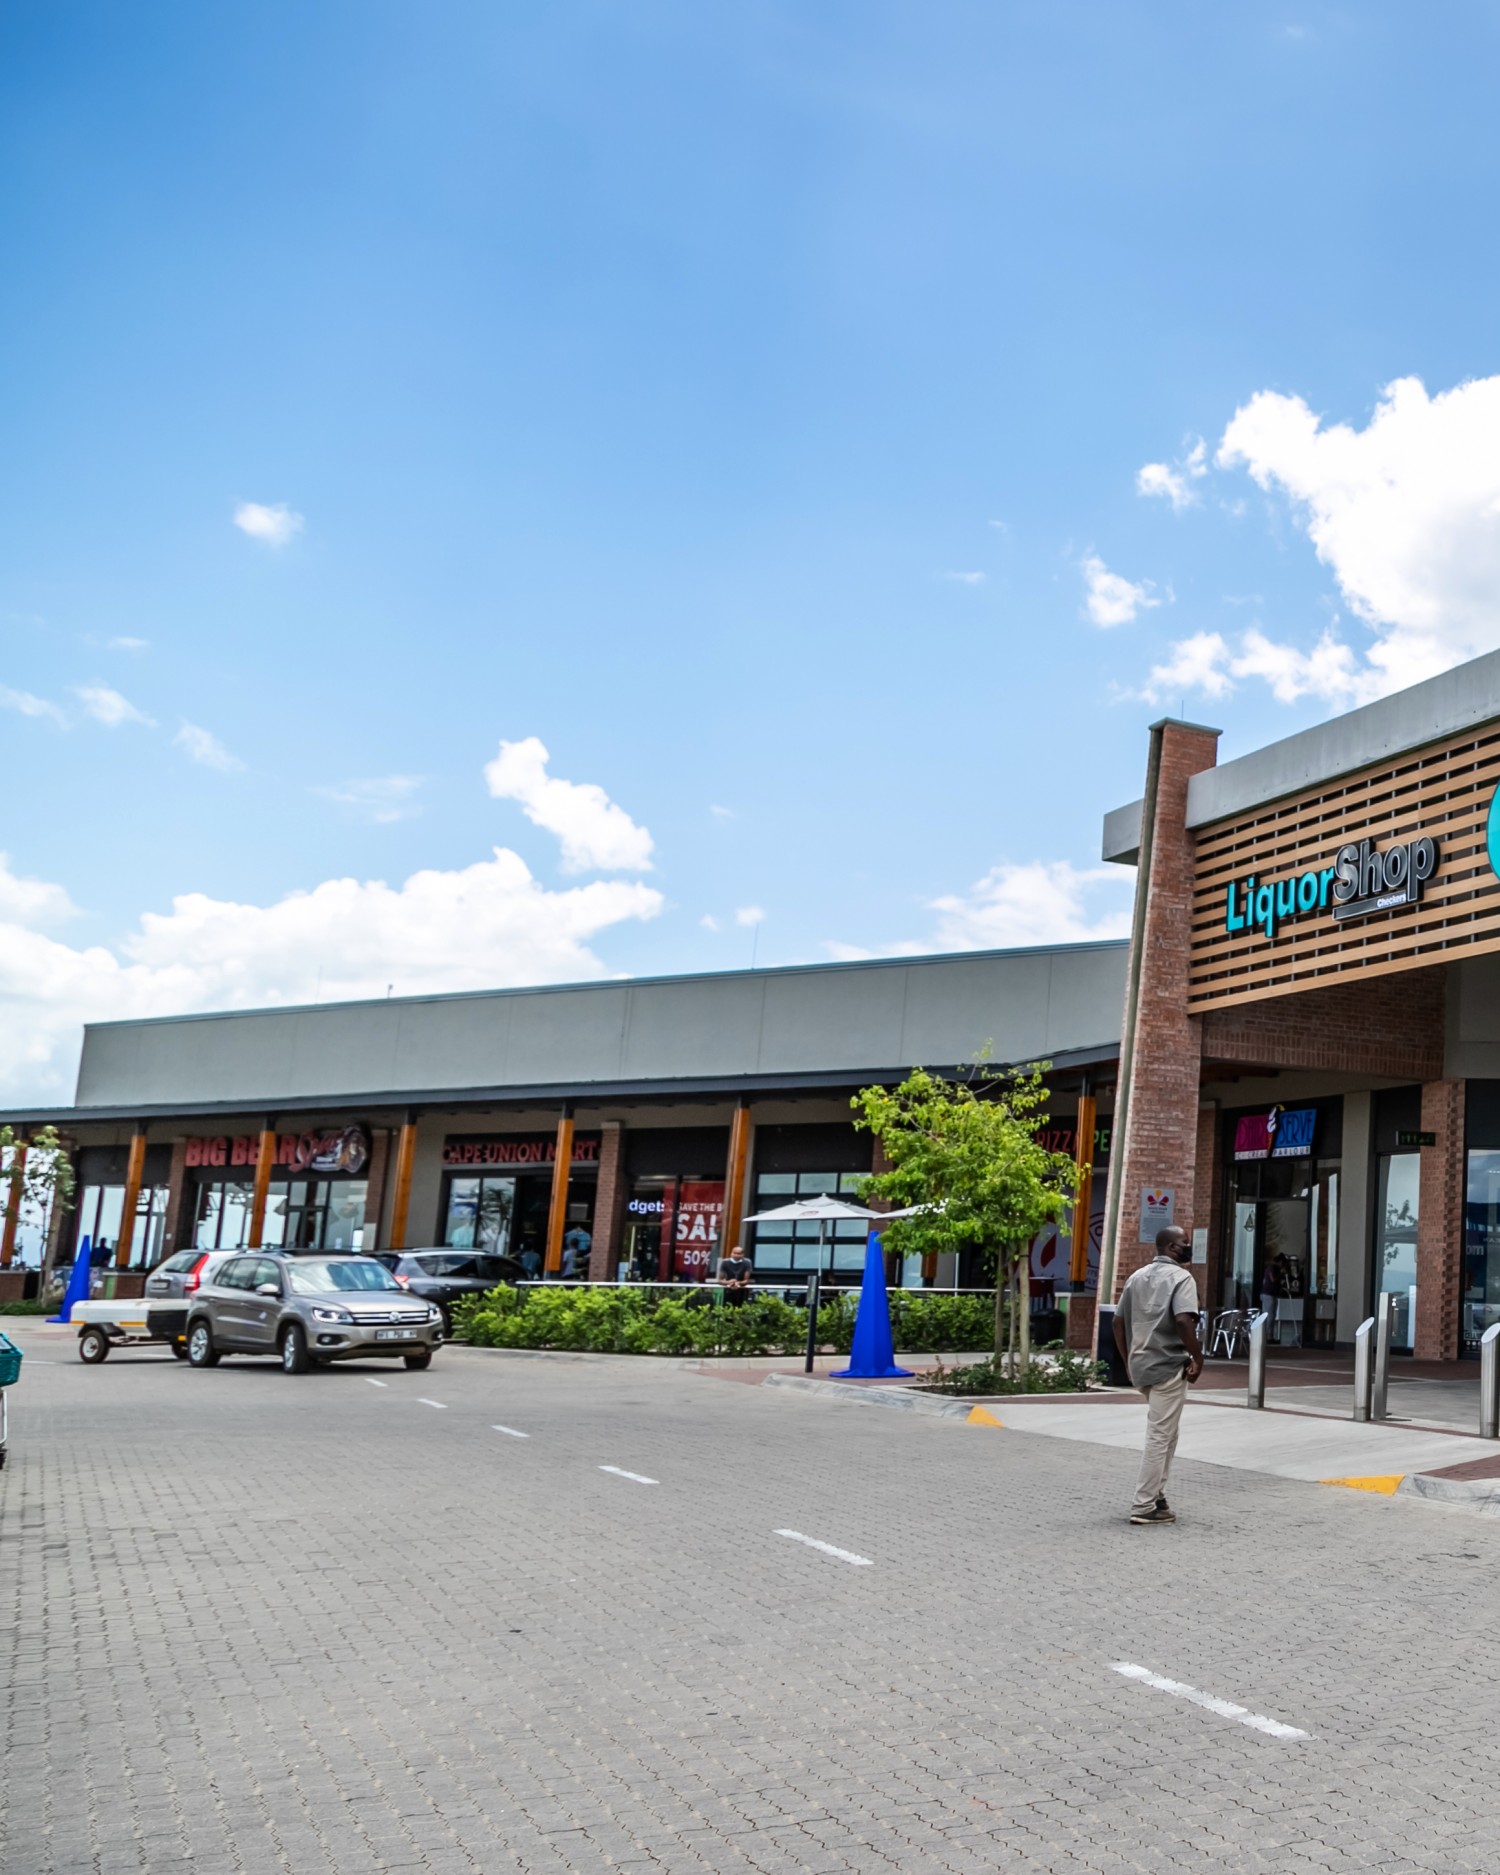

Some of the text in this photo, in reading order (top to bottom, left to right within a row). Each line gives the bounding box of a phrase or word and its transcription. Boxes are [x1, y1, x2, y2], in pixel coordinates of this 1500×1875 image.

[1377, 893, 1407, 908] Checkers
[185, 1136, 227, 1167] BIG
[230, 1135, 296, 1166] BER
[442, 1140, 598, 1164] CAPE UNION MRT
[676, 1213, 718, 1241] SAL
